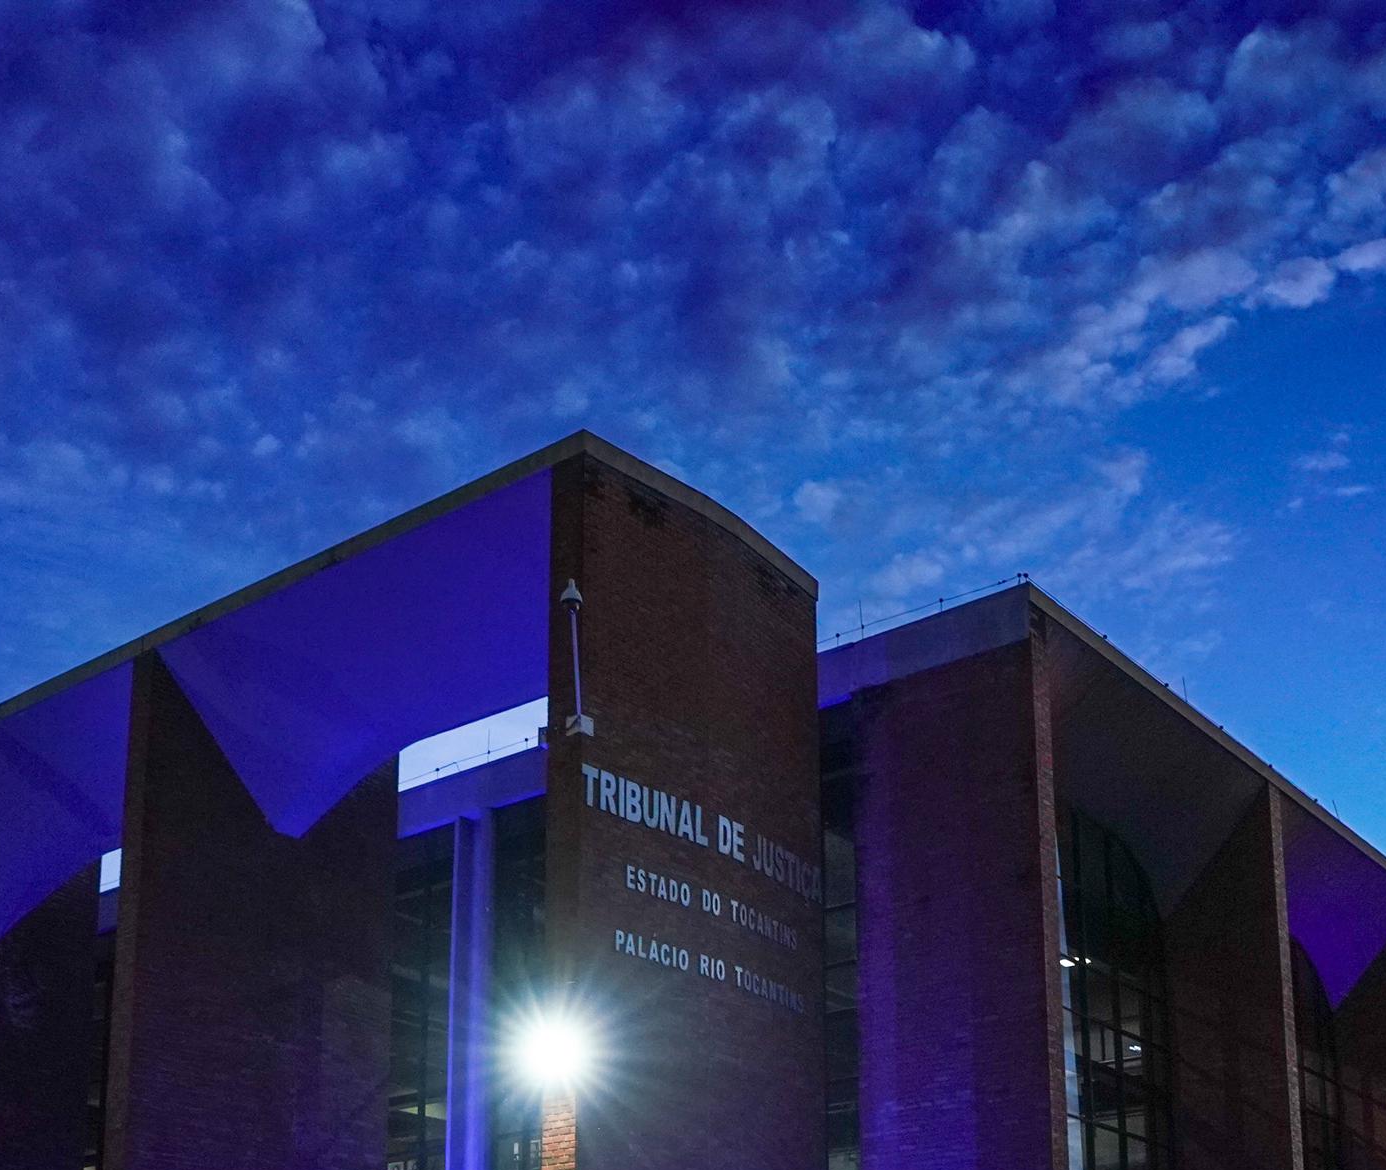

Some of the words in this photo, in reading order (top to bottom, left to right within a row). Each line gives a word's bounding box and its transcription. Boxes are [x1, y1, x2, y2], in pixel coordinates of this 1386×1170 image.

[581, 762, 709, 848] TRIBUNAL
[718, 814, 745, 863] DE
[626, 863, 691, 908] ESTADO
[702, 888, 721, 916] DO
[730, 898, 798, 951] TOCANTINS
[700, 953, 726, 981] RIO
[734, 965, 805, 1014] TOCANTINS
